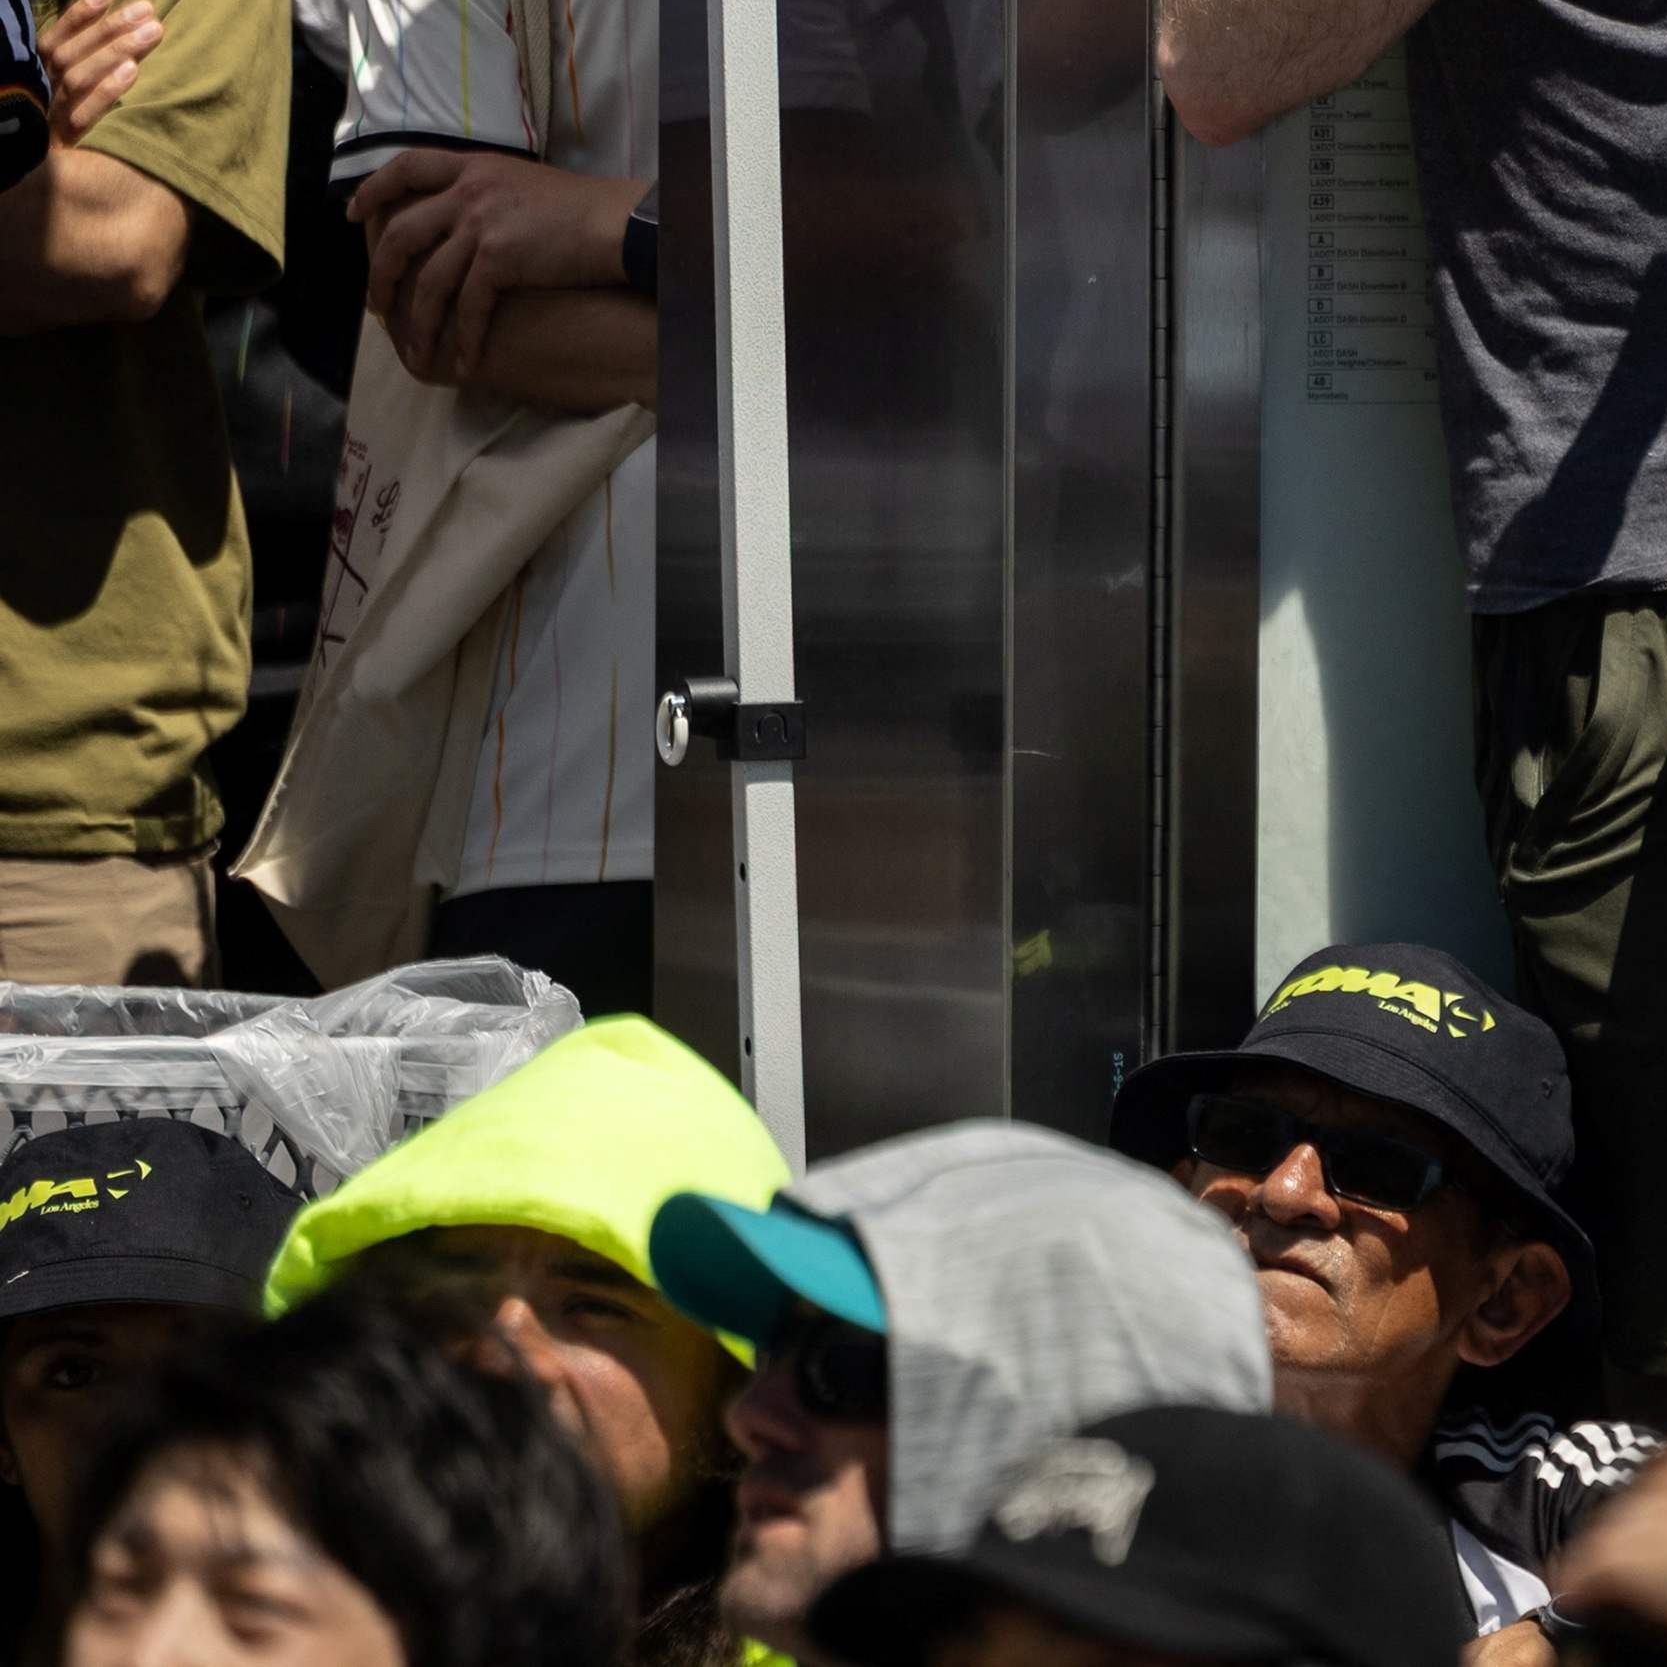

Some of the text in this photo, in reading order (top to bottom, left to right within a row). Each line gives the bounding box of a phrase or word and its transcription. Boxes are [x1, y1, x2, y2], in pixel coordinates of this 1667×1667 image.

[1313, 334, 1327, 344] LC
[1336, 349, 1358, 358] DASH
[1378, 1000, 1440, 1035] Los Angeles
[40, 1198, 100, 1216] Los Angeles
